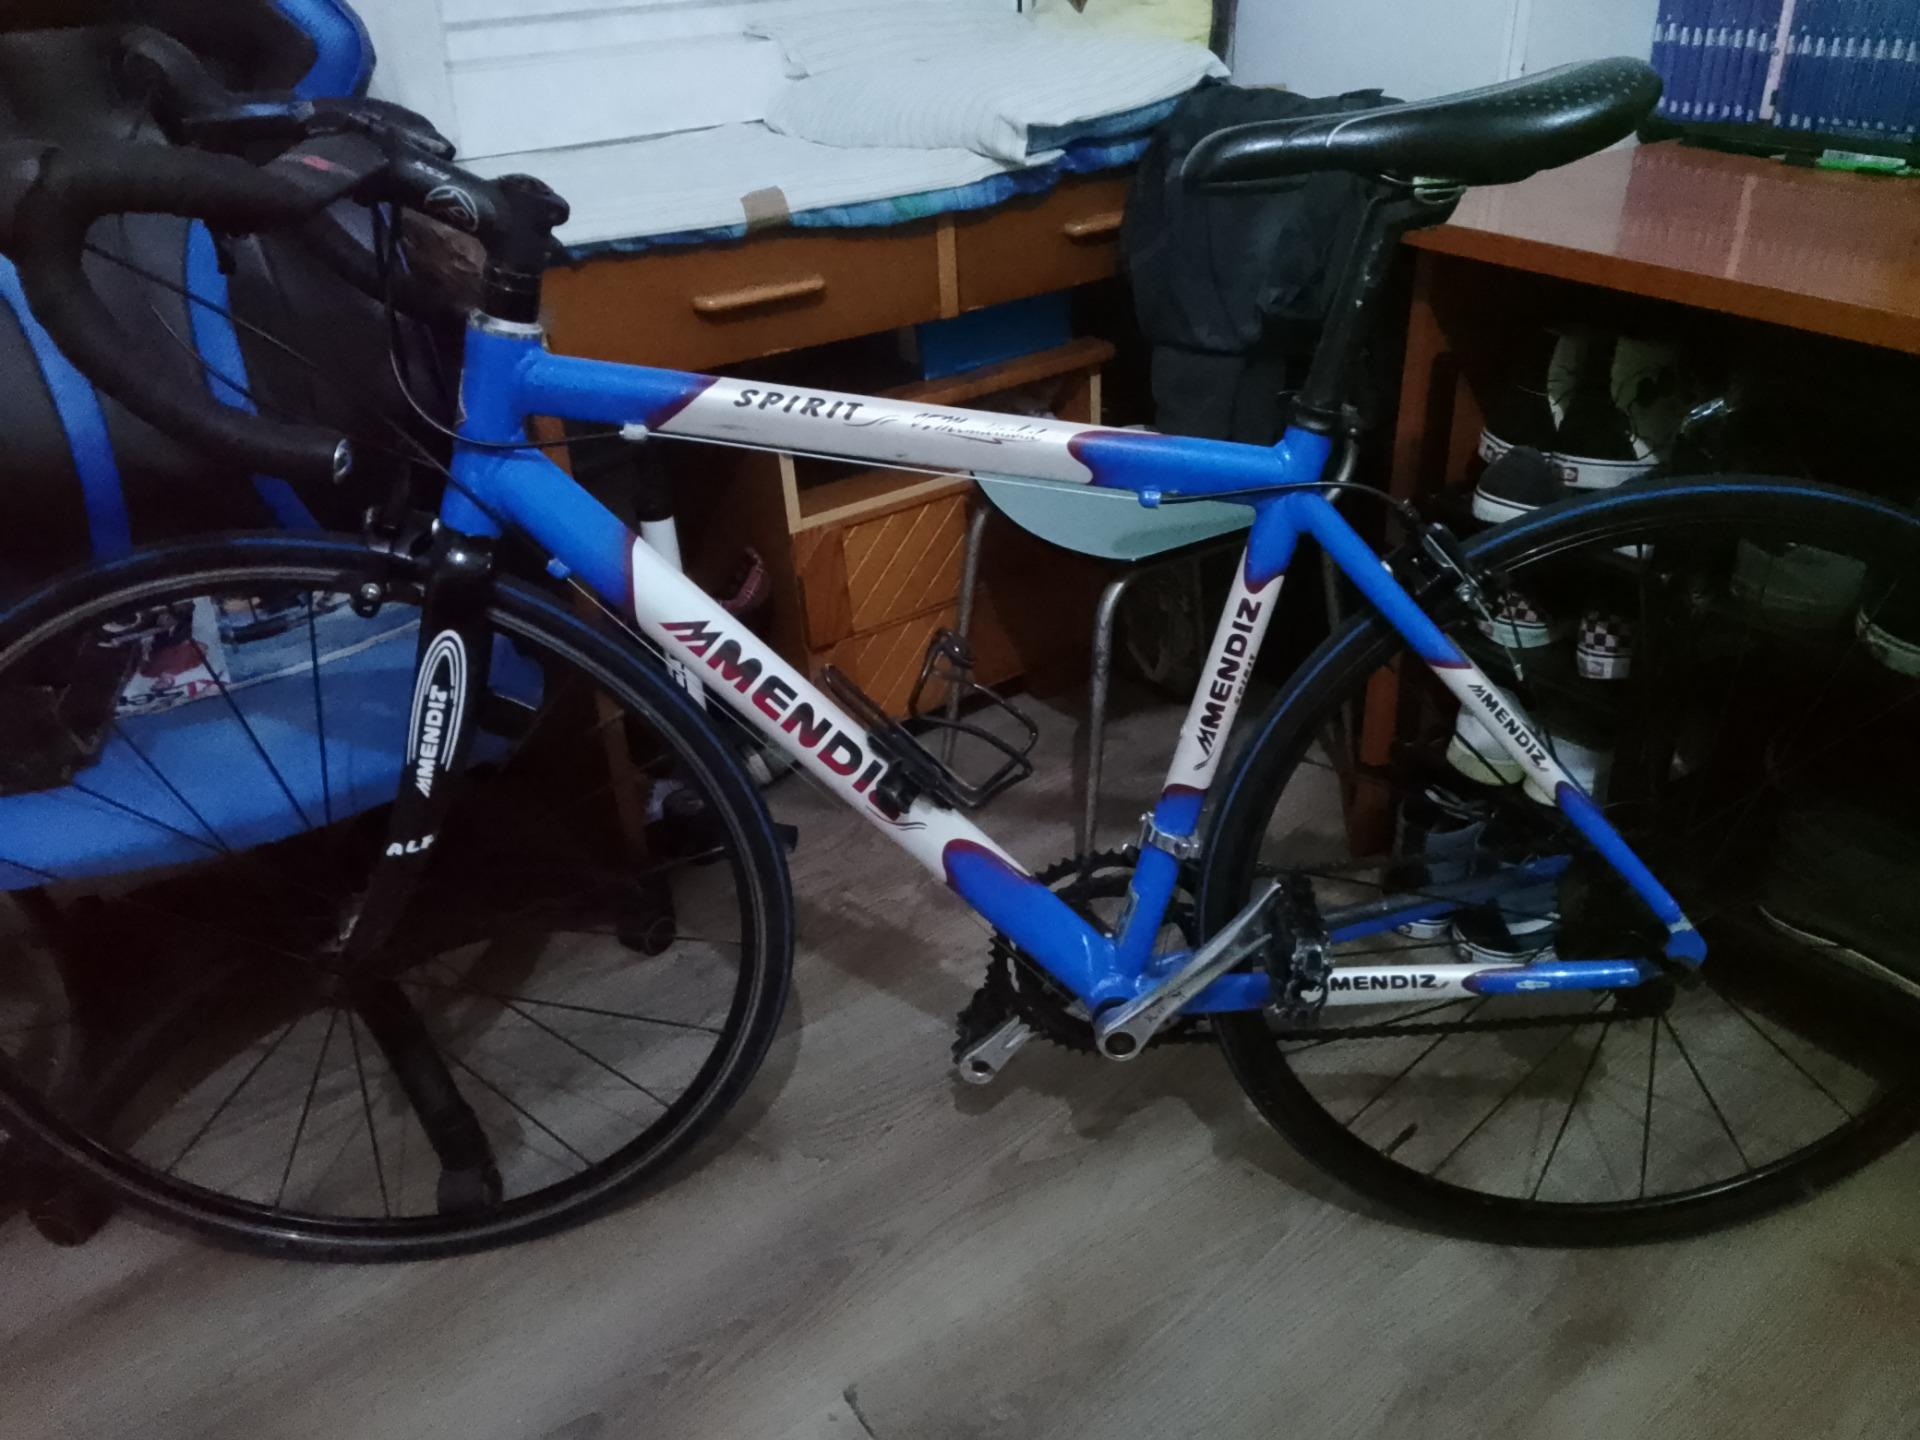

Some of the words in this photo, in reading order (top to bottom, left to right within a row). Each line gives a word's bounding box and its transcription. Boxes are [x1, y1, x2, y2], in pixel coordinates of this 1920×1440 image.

[733, 388, 864, 422] SPIRIT
[1201, 597, 1262, 730] MENDIZ
[706, 638, 902, 822] MENDI
[1481, 692, 1547, 767] MENDIZ
[1329, 974, 1438, 992] MENDIZ
